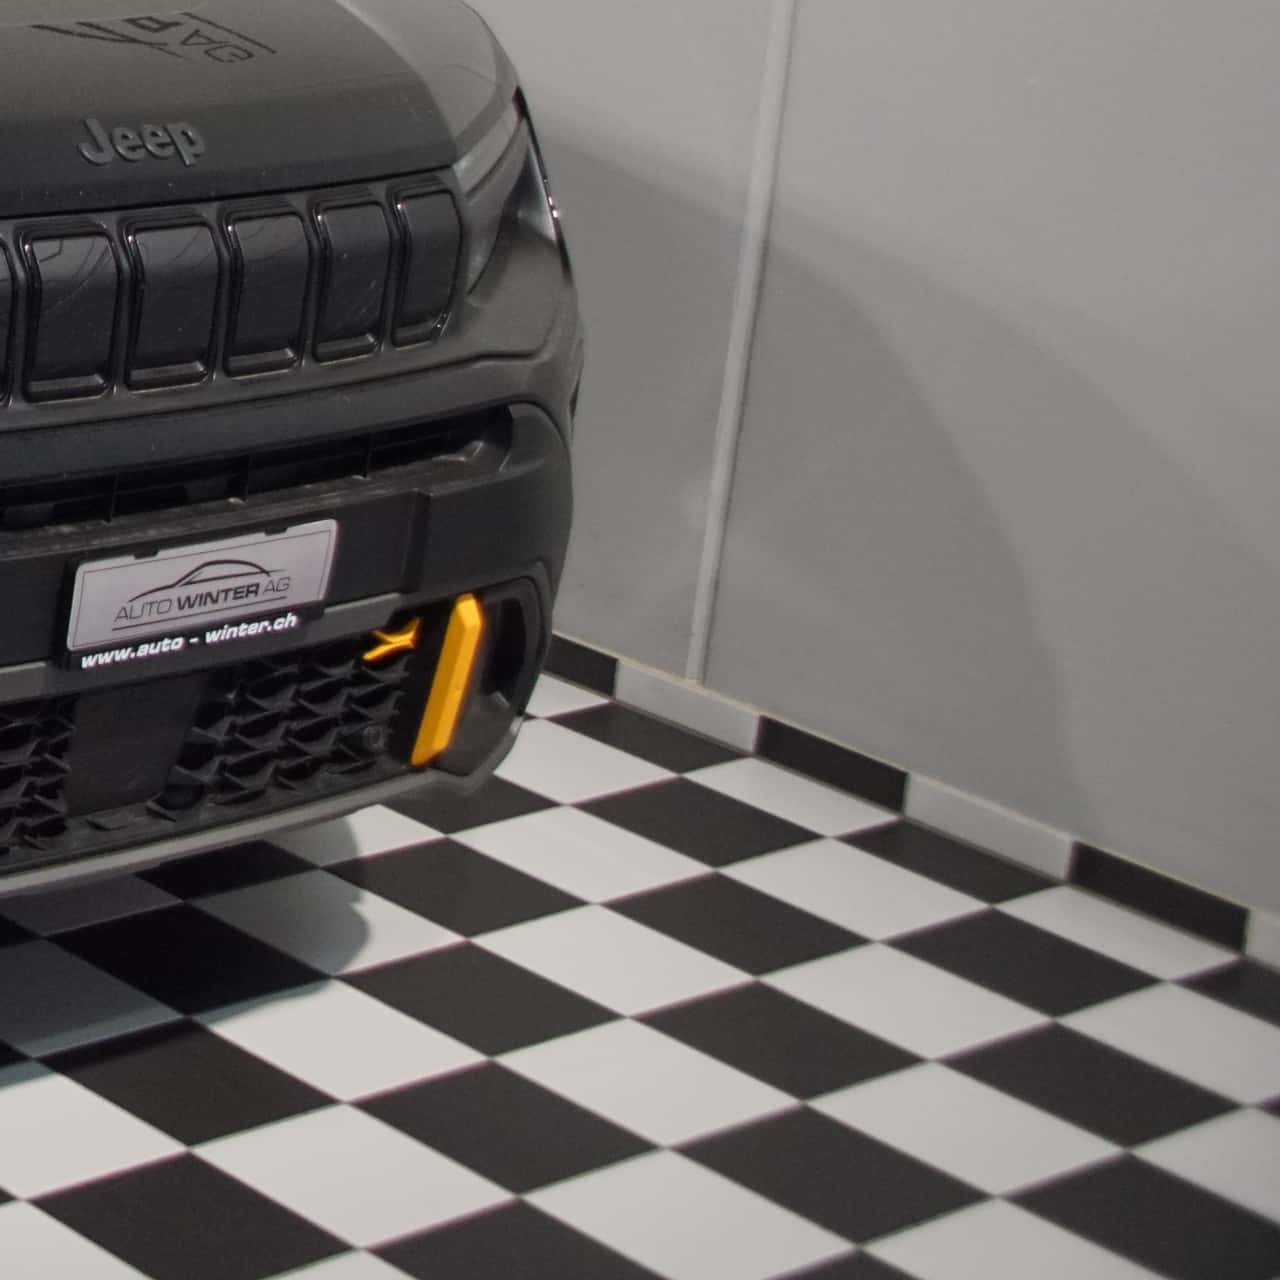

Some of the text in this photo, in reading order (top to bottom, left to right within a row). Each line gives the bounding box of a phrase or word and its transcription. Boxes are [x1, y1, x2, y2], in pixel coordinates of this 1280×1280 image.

[77, 119, 206, 167] Jeep
[113, 576, 291, 622] AUTO WINTER AG
[80, 634, 185, 669] www.auto
[204, 612, 298, 644] winter.ch
